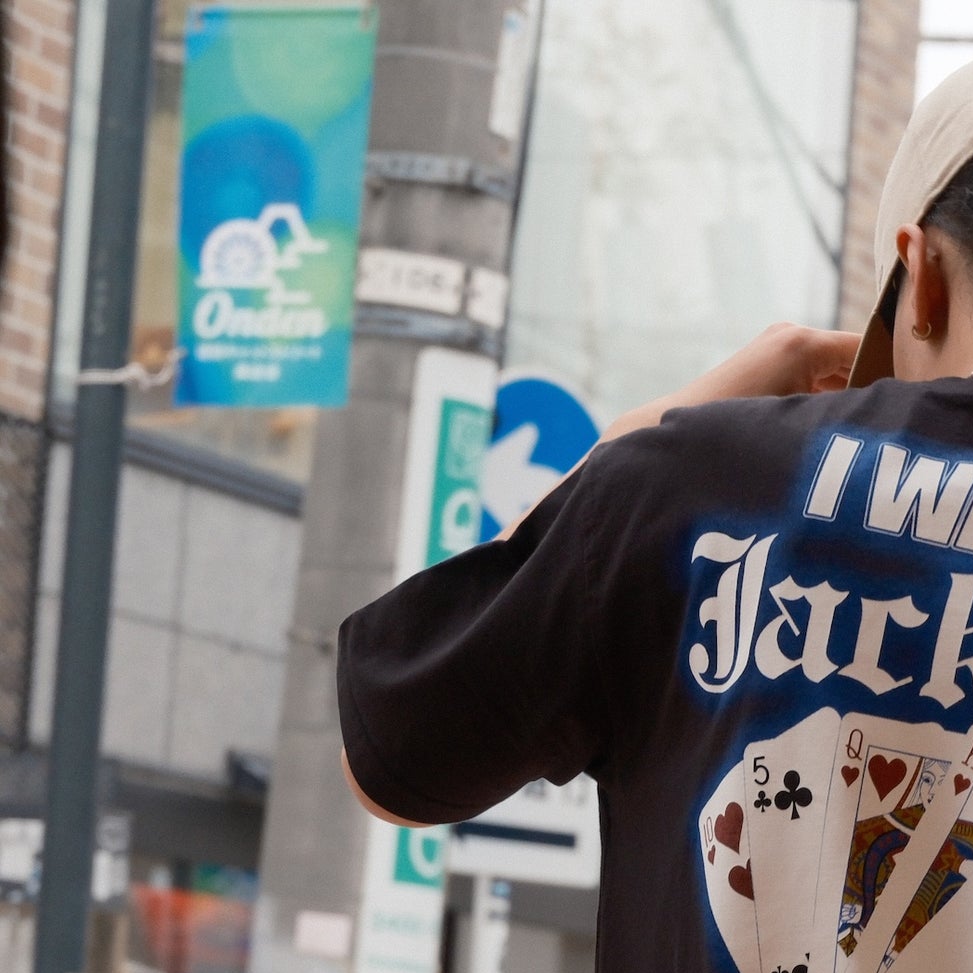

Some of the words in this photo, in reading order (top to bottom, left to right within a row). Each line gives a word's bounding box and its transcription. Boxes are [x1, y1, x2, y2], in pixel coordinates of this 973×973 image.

[803, 433, 862, 521] I
[845, 729, 864, 761] Q
[752, 756, 770, 786] 5
[703, 816, 714, 849] 10
